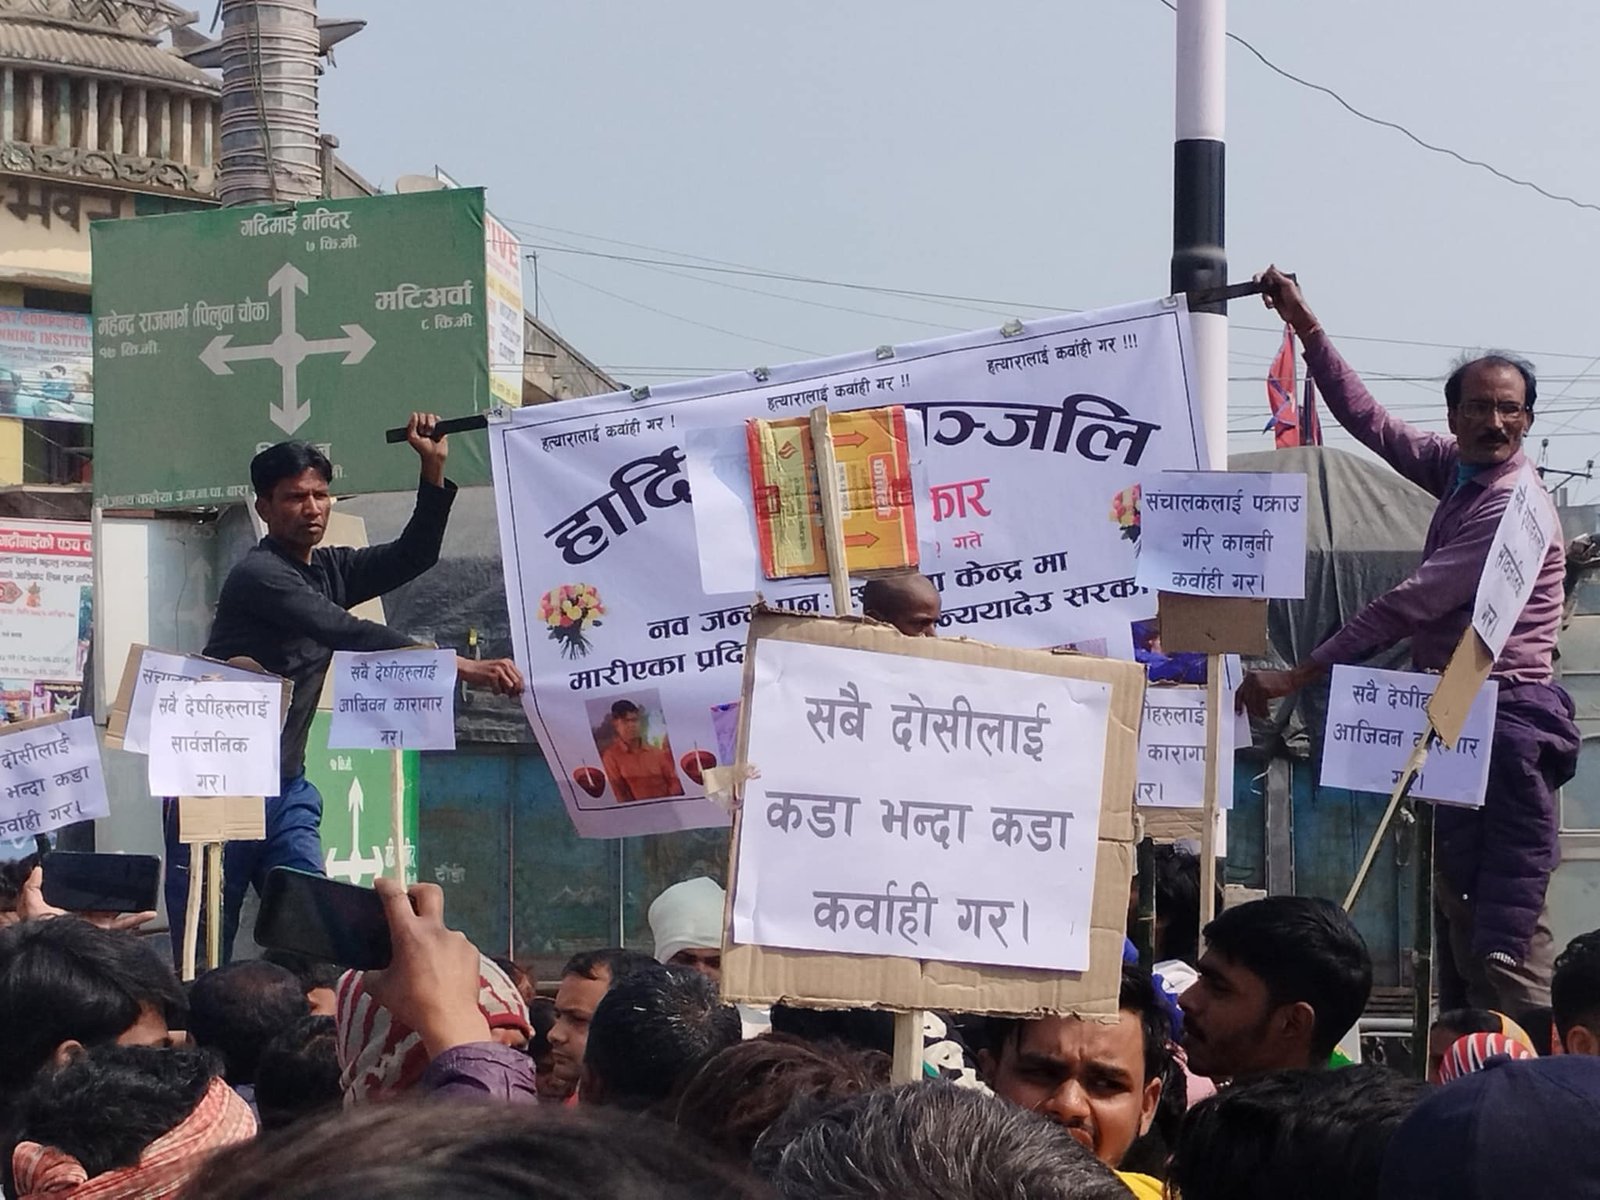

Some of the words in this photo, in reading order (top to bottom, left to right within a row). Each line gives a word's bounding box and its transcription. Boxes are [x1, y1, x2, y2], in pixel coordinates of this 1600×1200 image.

[302, 207, 352, 232] मन्दिर
[97, 309, 136, 338] महेन्द्र
[139, 302, 190, 333] राजमार्ग
[40, 332, 93, 348] INSTITU
[1097, 337, 1116, 353] गर
[876, 376, 895, 392] गर
[605, 418, 641, 437] कर्वाही
[1145, 489, 1243, 515] संचालकलाई
[1252, 495, 1302, 513] पक्राउ
[1182, 527, 1214, 554] गरि
[1221, 529, 1273, 558] कानुनी
[1172, 567, 1224, 594] कर्वाही
[647, 615, 690, 640] नव
[954, 560, 1023, 588] केन्द्र
[1033, 551, 1069, 574] मा
[569, 654, 687, 690] मारीएका
[695, 640, 748, 673] प्रदि
[393, 696, 443, 714] कारागार
[1352, 679, 1380, 705] सबै
[1388, 683, 1433, 712] देषीह
[804, 681, 872, 744] सबै
[890, 692, 1052, 762] दोसीलाई
[1333, 719, 1404, 747] आजिवन
[1, 733, 70, 769] दोसीलाई
[171, 730, 250, 754] सार्वजनिक
[6, 778, 46, 799] भन्दा
[53, 766, 90, 787] कडा
[764, 790, 861, 839] कडा
[880, 797, 973, 850] भन्दा
[990, 805, 1075, 852] कडा
[812, 880, 938, 946] कर्वाही
